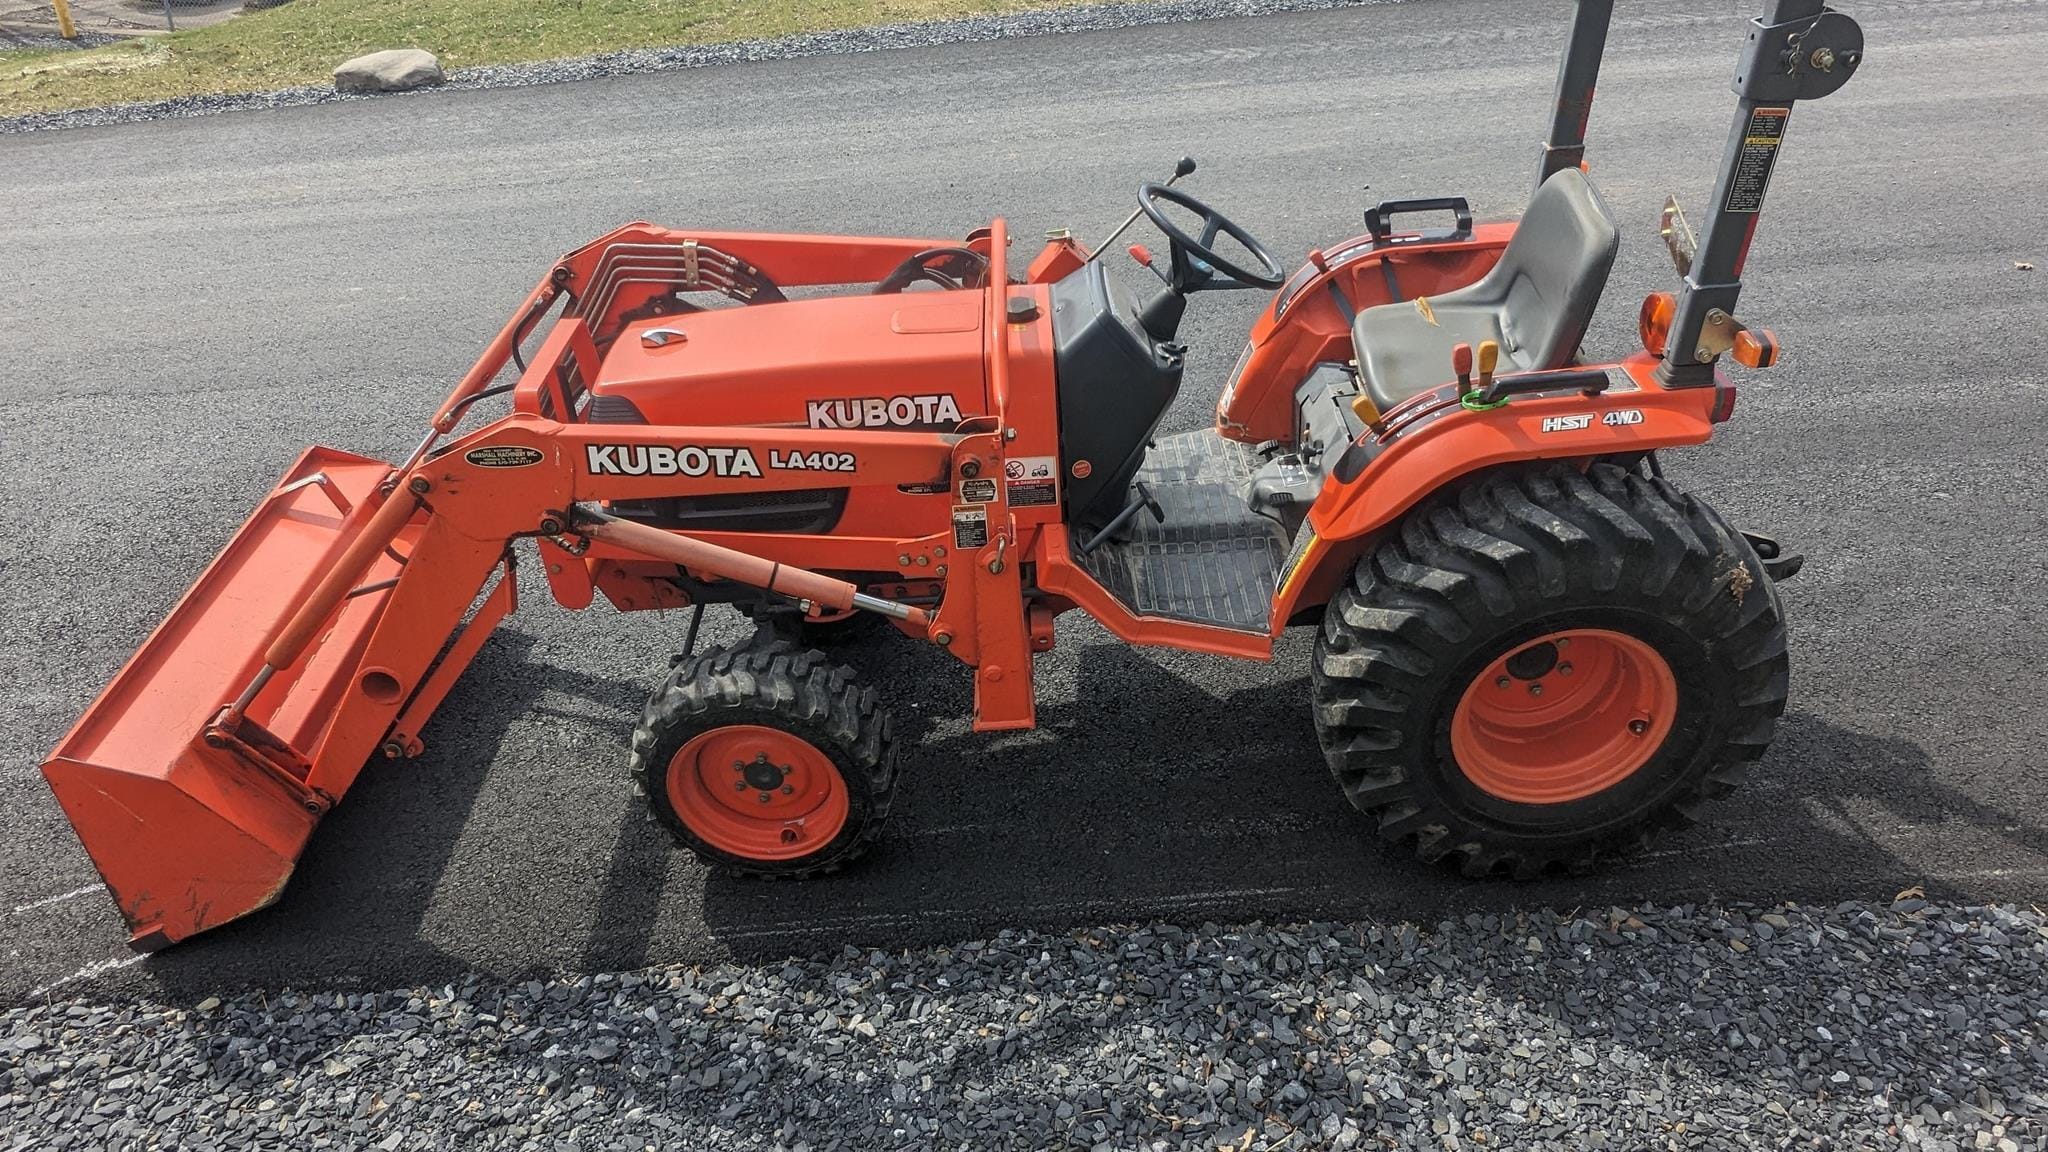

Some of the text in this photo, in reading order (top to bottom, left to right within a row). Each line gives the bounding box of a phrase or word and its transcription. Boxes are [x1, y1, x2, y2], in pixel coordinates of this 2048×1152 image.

[807, 394, 962, 429] KUBOTA
[1542, 409, 1644, 432] HST 4WD
[587, 445, 855, 477] KUBOTA LA402
